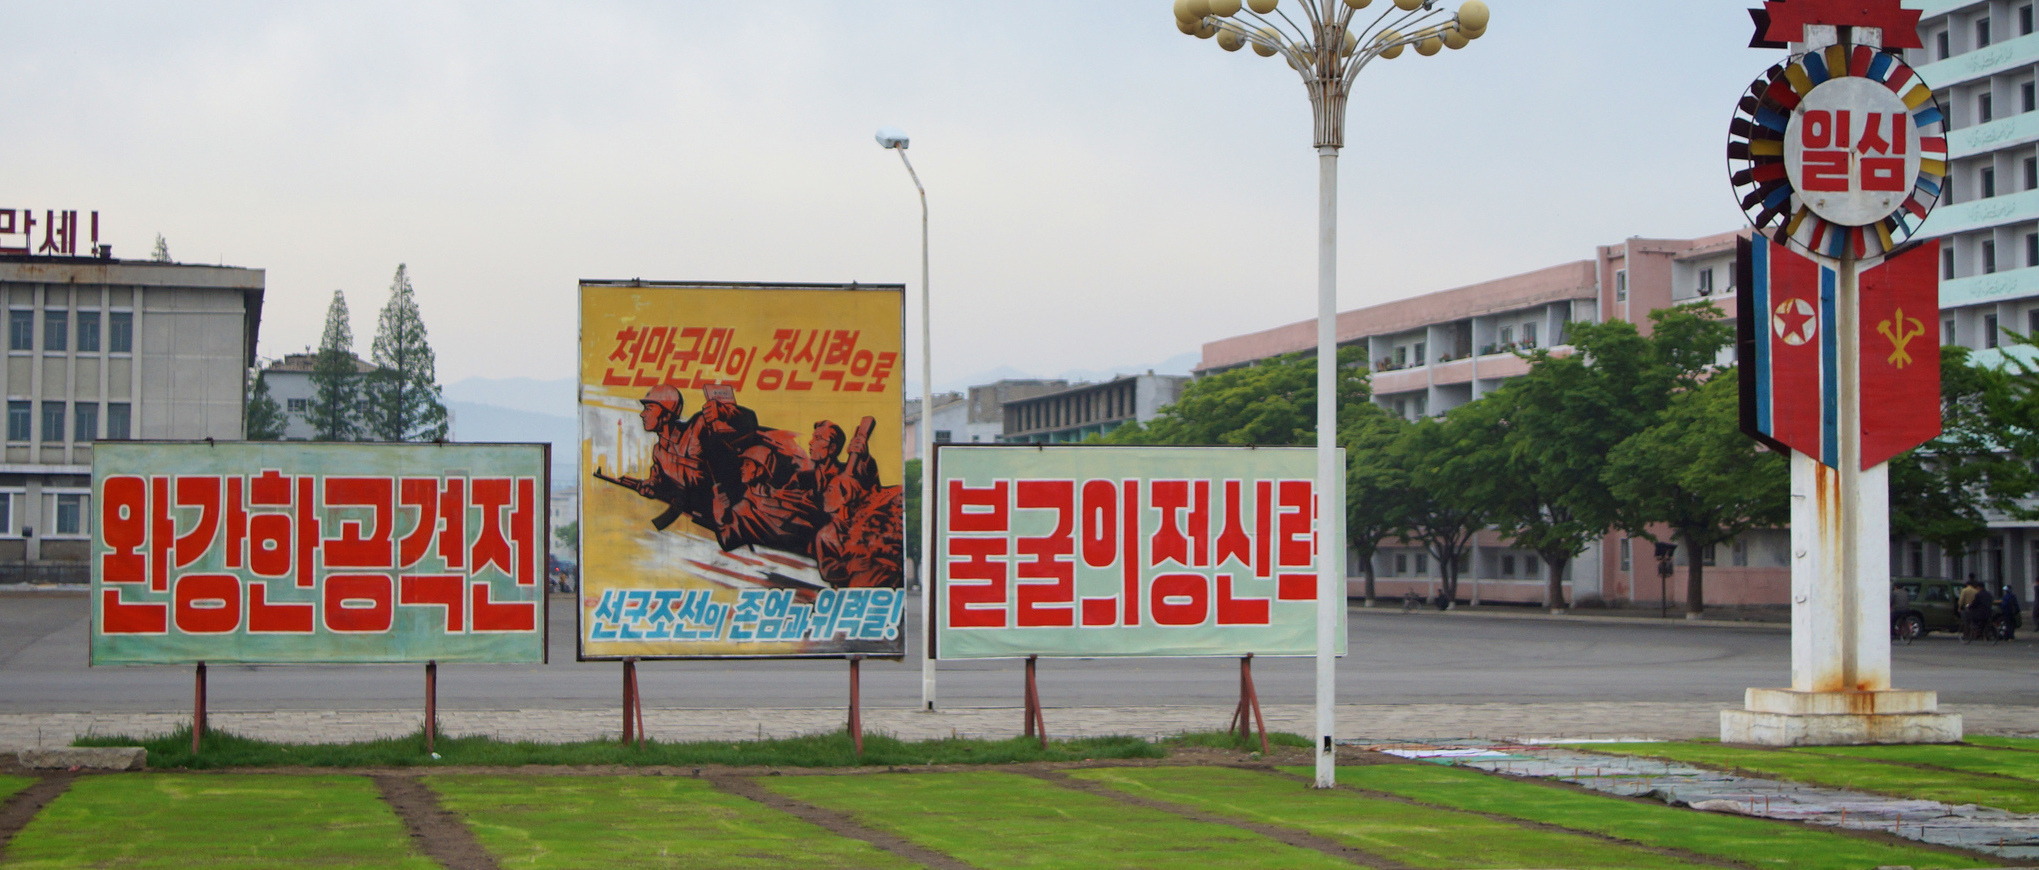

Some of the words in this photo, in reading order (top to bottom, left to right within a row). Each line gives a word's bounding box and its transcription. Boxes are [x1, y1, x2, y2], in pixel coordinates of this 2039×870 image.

[1801, 109, 1907, 192] 일심
[0, 209, 99, 254] 만세!
[602, 326, 757, 392] 천만군민의
[756, 328, 898, 392] 정신력으로
[591, 589, 730, 640] 선군조선의
